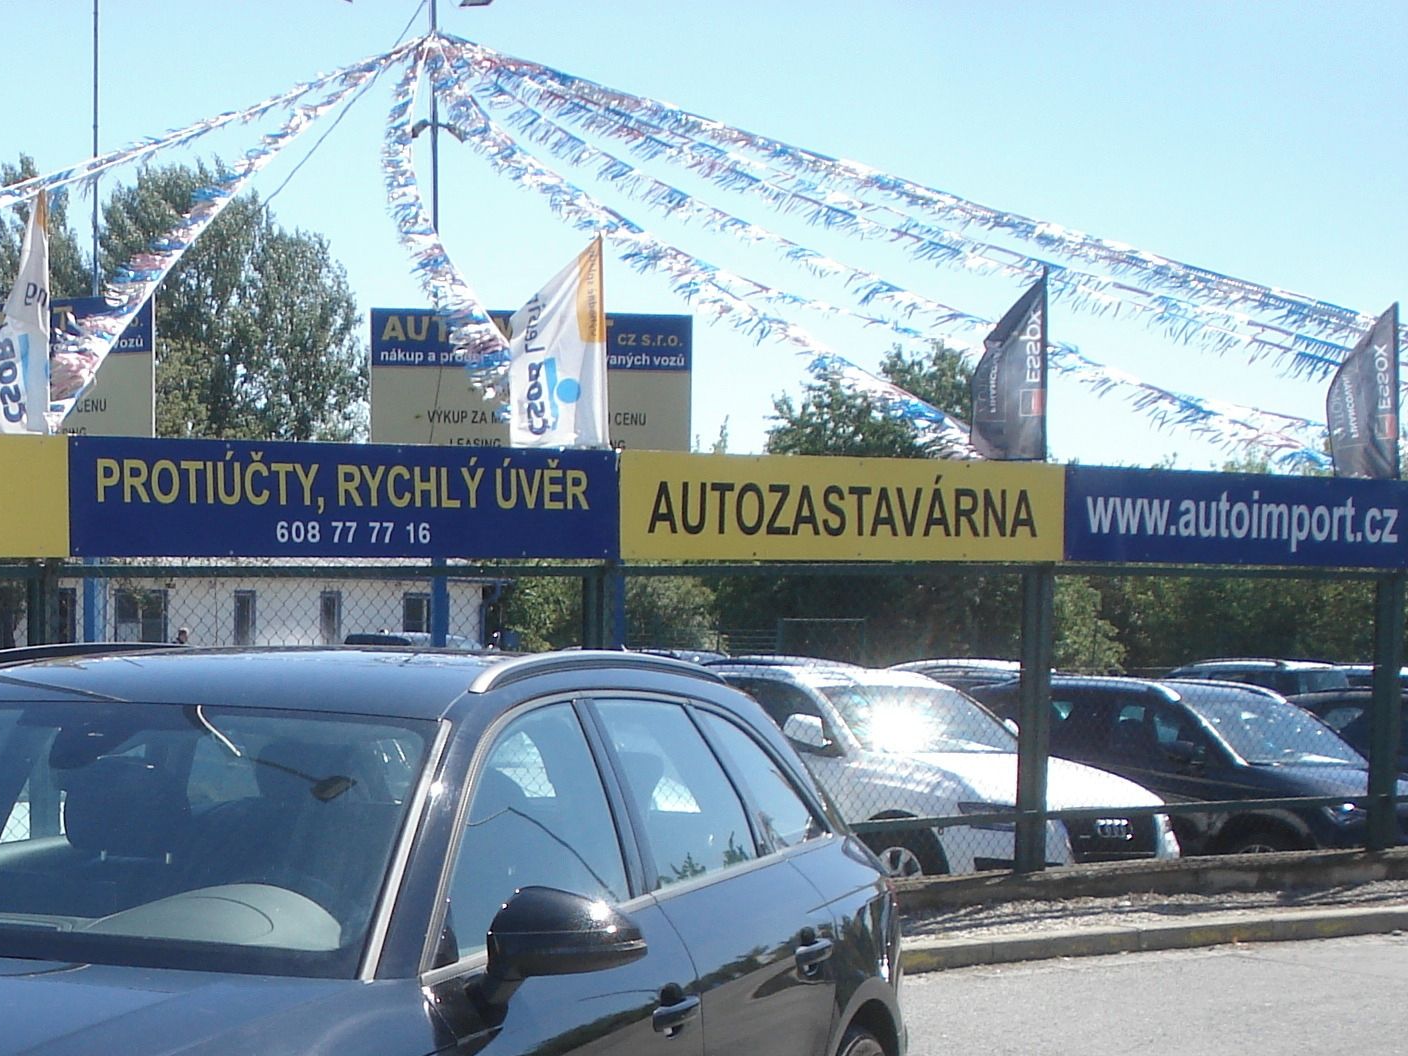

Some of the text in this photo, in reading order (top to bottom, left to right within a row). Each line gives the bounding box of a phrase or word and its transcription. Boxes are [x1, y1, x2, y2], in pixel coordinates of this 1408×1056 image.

[380, 348, 423, 364] nákup
[428, 352, 435, 362] a
[428, 406, 468, 424] VÝKUP
[472, 410, 488, 424] ZA
[614, 412, 647, 426] CENU
[96, 450, 590, 514] PROTIÚČTY, RYCHLÝ ÚVĚR
[648, 475, 1038, 538] AUTOZASTAVÁRNA
[1086, 489, 1400, 552] www.autoimport.cz
[276, 520, 431, 544] 608 77 77 16
